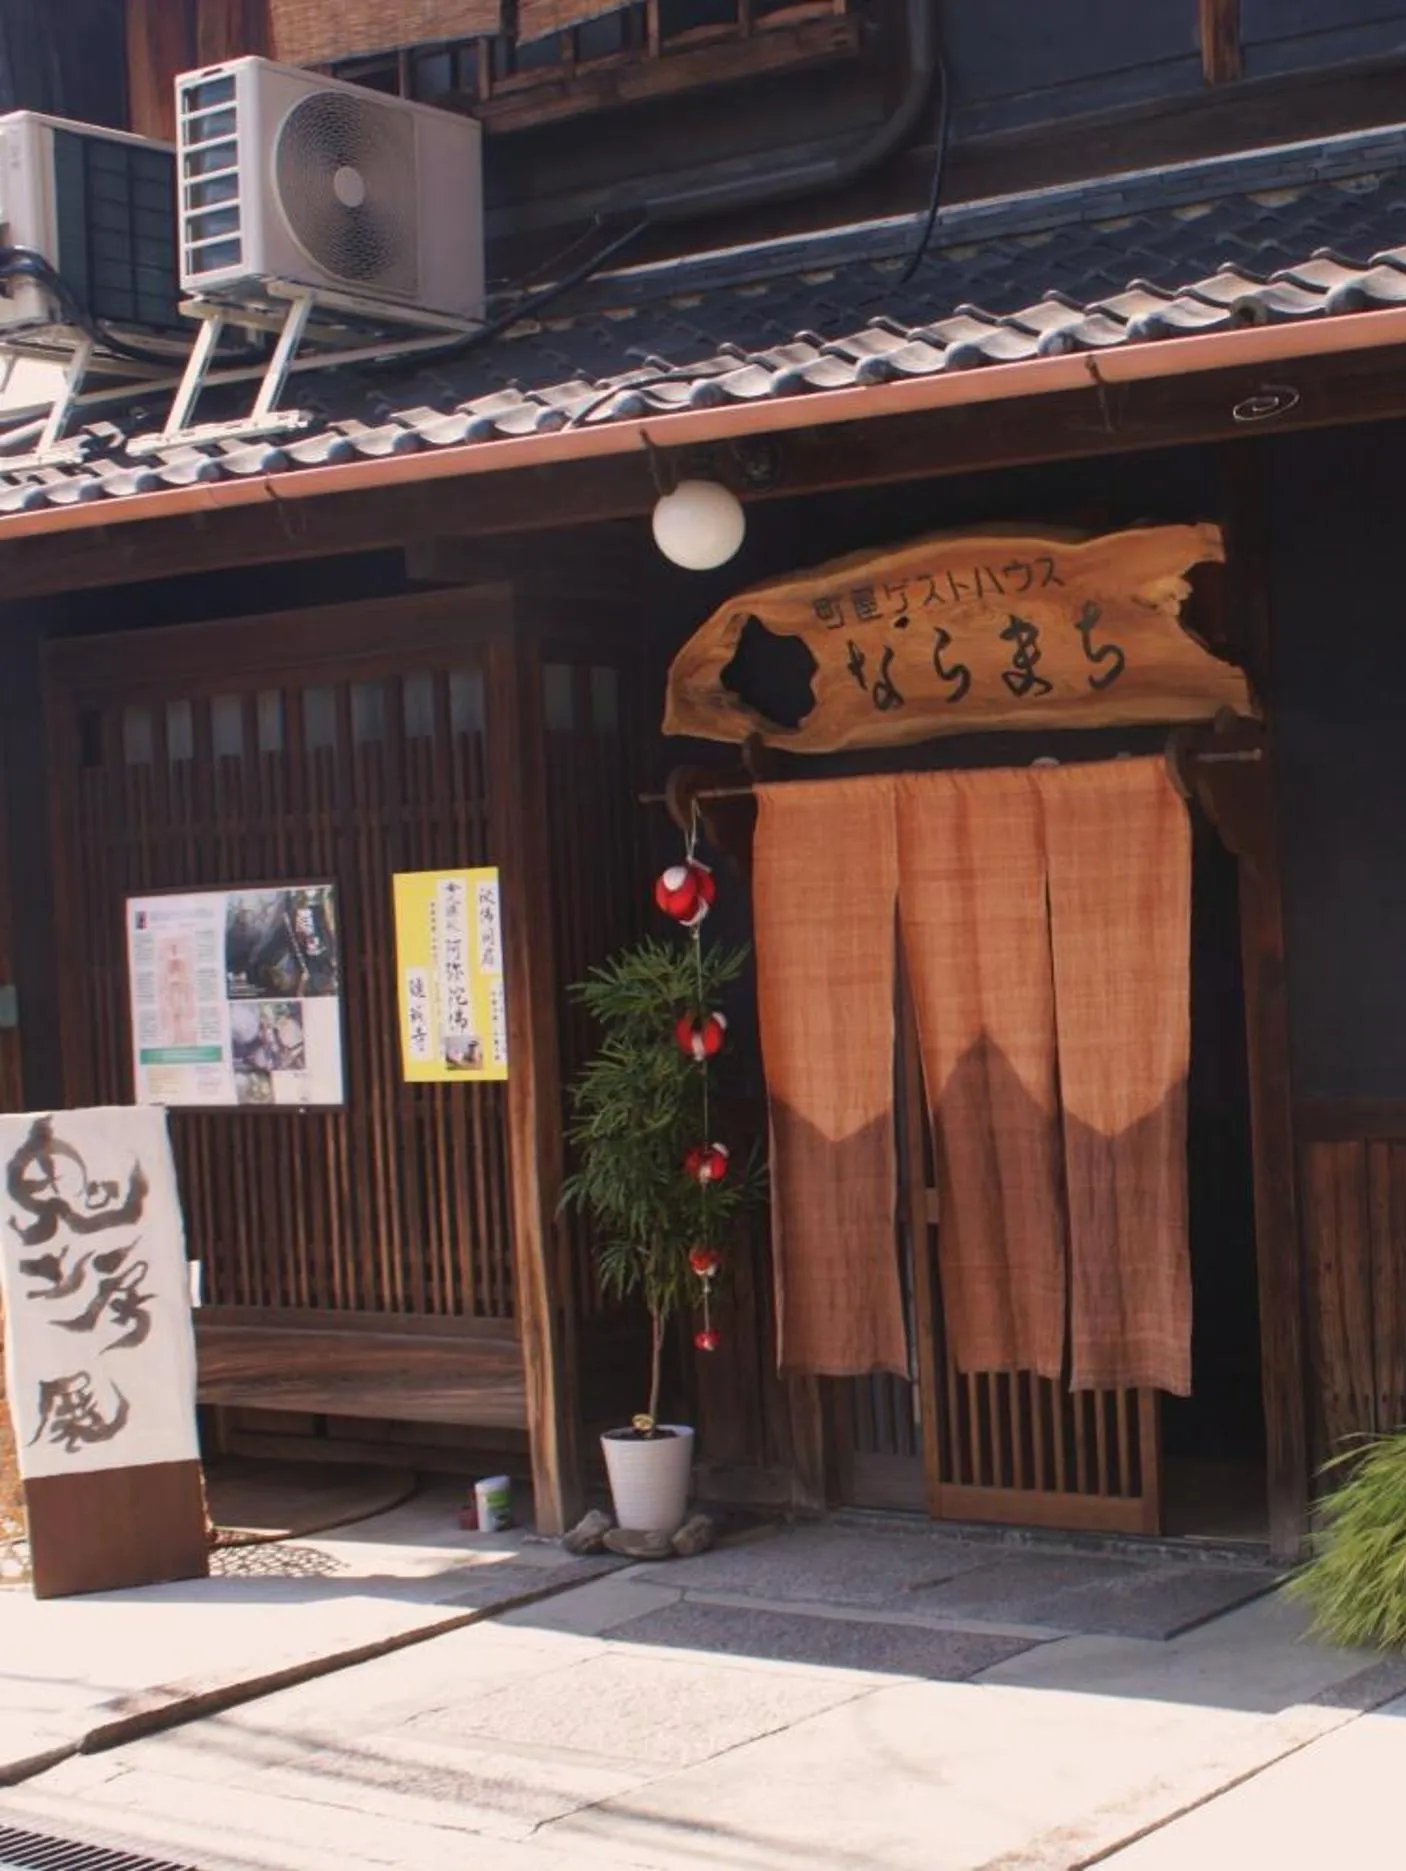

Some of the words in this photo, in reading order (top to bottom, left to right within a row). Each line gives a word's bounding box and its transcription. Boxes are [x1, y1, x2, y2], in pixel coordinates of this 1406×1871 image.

[811, 556, 1067, 630] 町屋ゲストハウス
[846, 600, 1127, 711] ならまち
